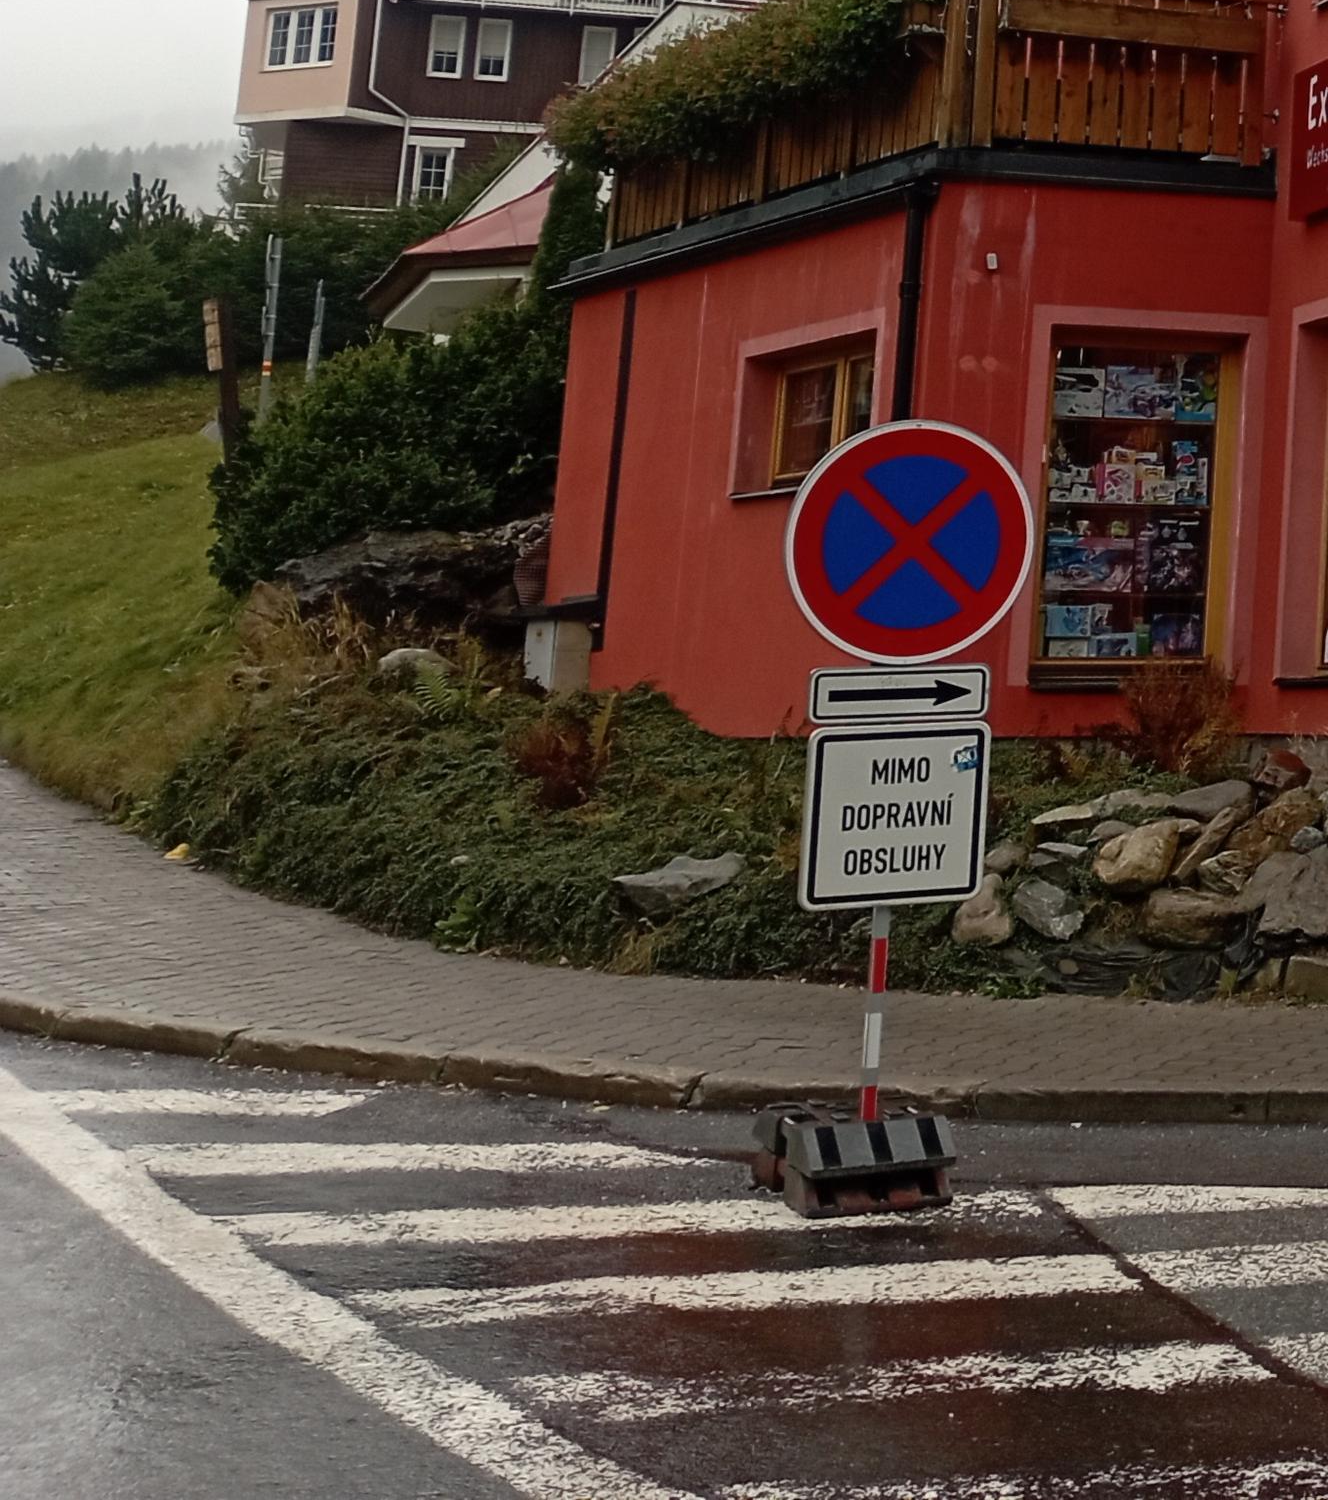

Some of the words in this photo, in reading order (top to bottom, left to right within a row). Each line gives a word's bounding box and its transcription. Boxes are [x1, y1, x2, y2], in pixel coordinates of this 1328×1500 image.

[871, 757, 931, 785] MIMO
[842, 793, 954, 832] DOPRAVNÍ
[844, 844, 946, 876] OBSLUHY
